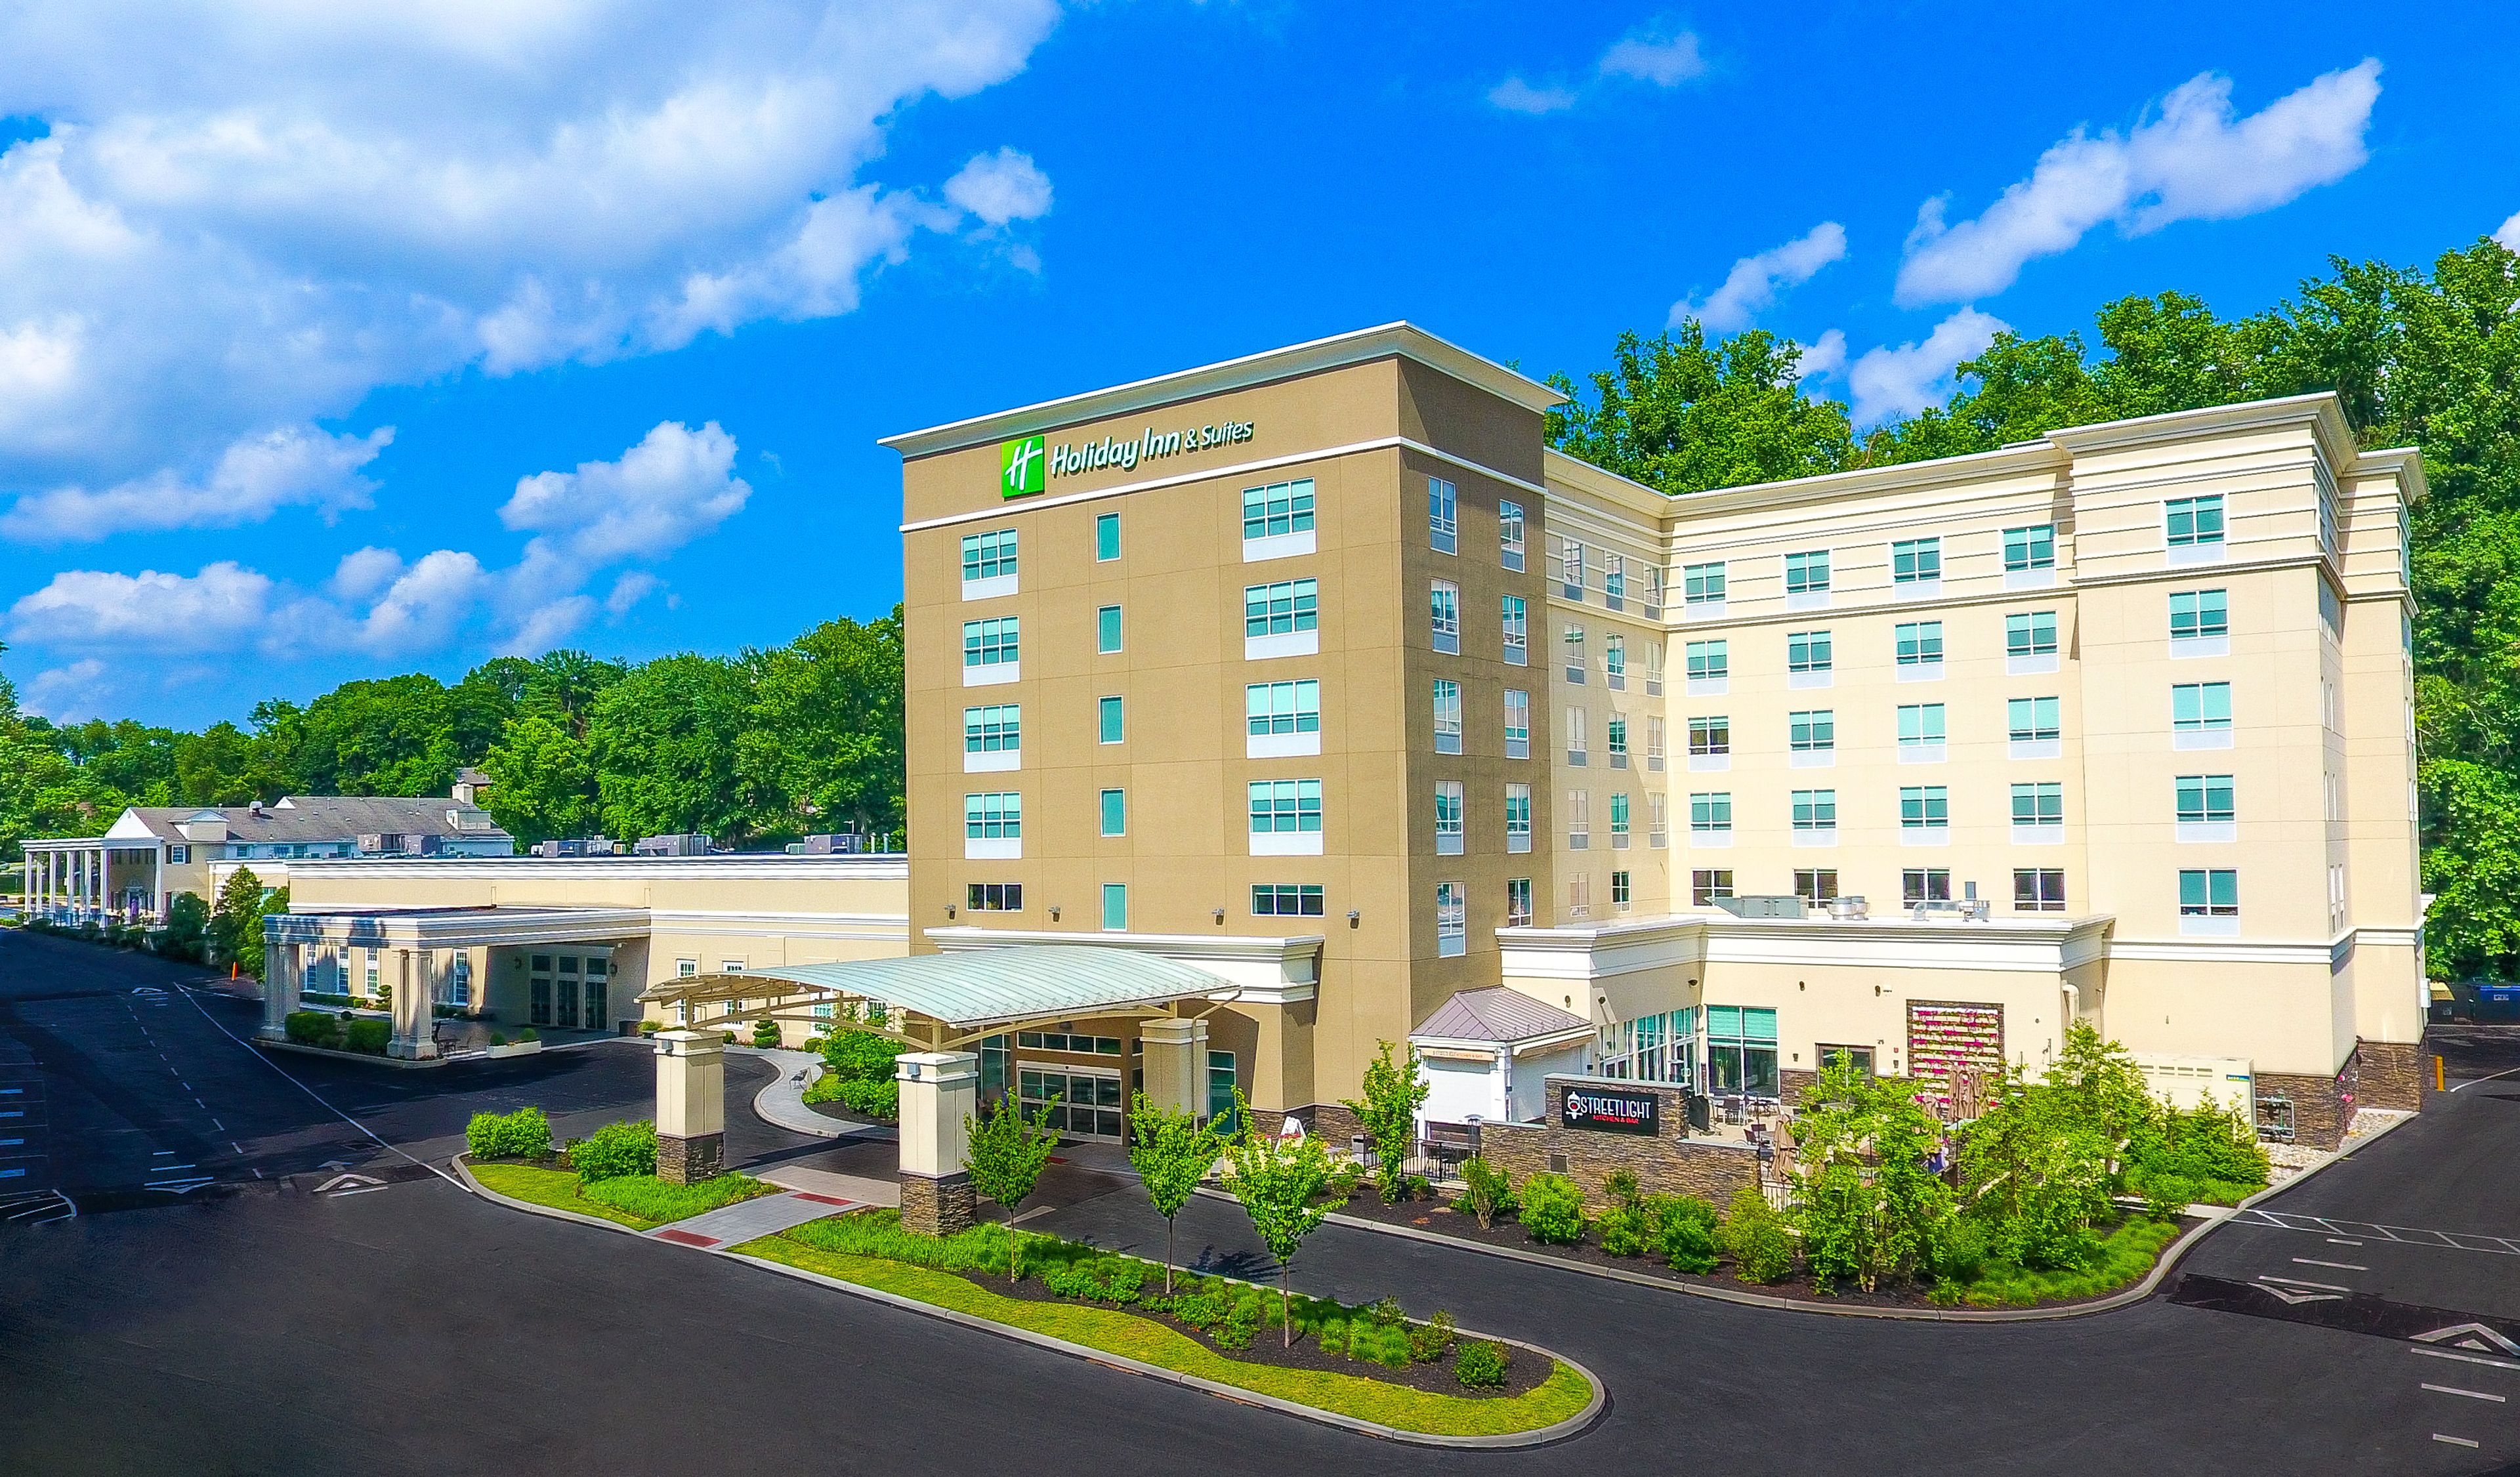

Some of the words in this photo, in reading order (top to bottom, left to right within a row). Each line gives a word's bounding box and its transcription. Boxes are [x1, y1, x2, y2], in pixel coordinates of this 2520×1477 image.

[1050, 436, 1139, 474] Holiday
[1143, 427, 1180, 457] Inn
[1184, 428, 1198, 449] &
[1200, 421, 1253, 446] Suites
[1581, 1096, 1650, 1119] STREETLIGHT
